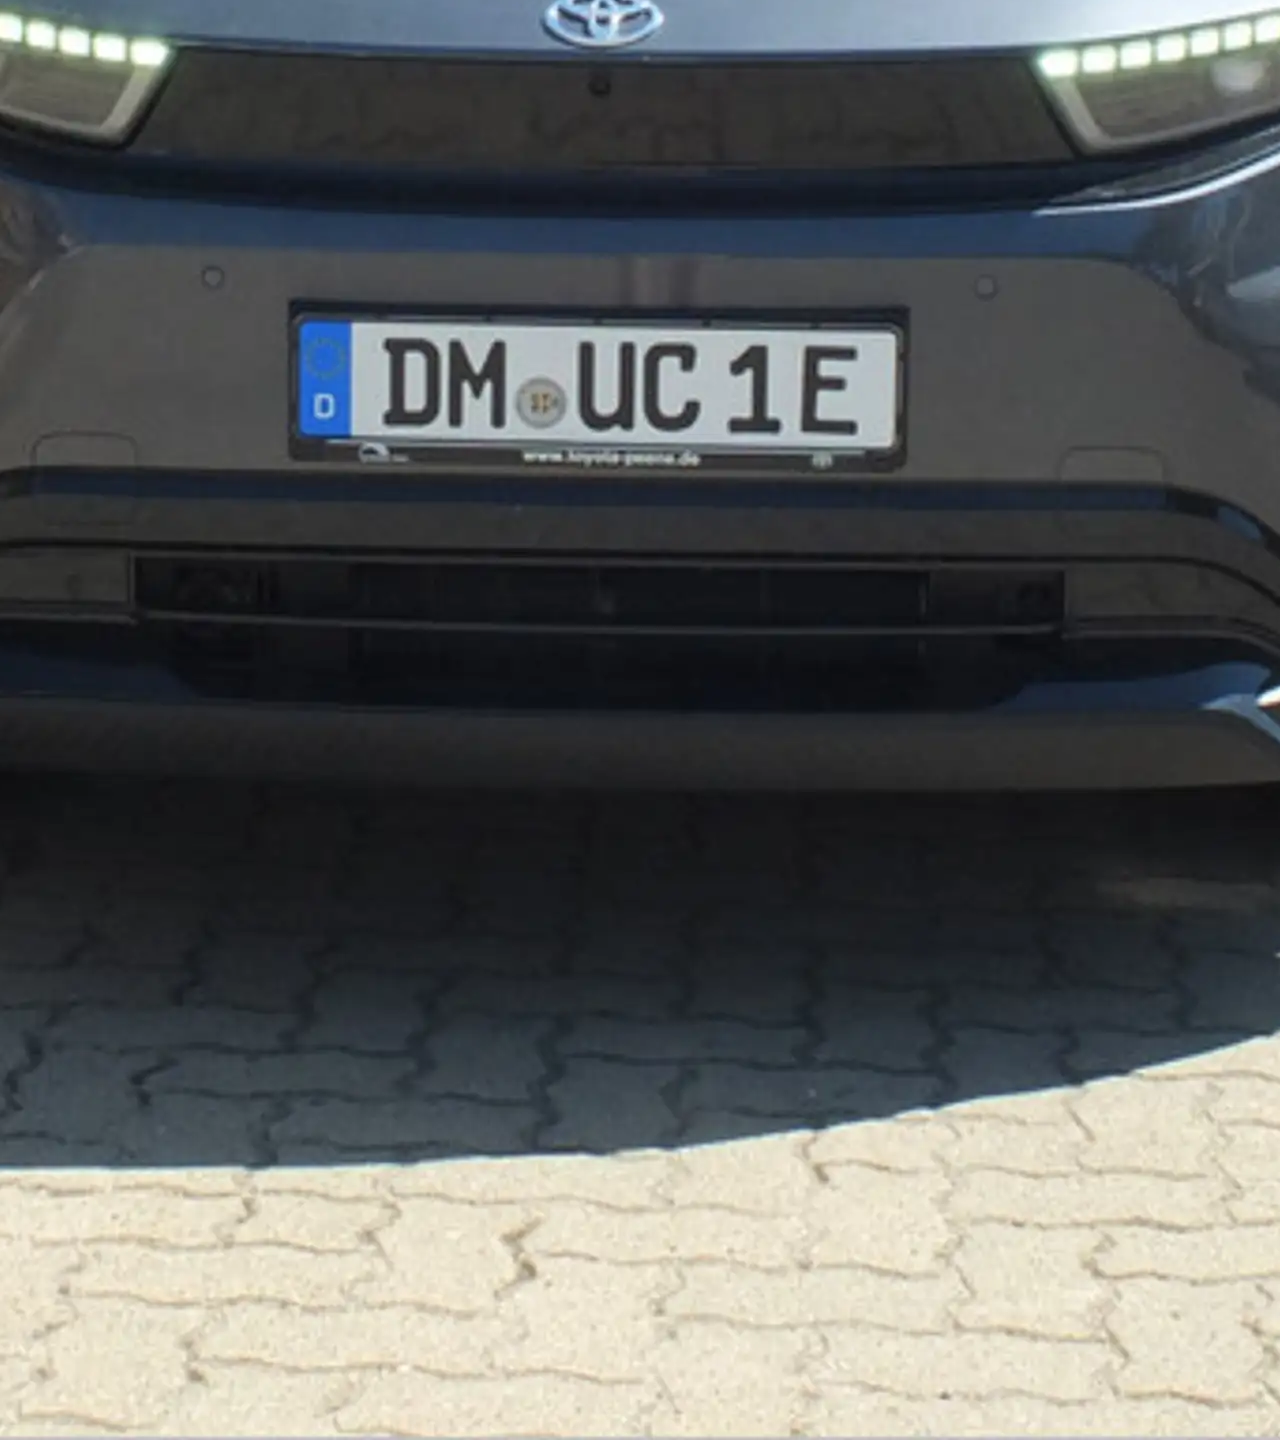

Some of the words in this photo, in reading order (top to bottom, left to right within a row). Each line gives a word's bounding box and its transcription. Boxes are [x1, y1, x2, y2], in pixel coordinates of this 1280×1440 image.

[313, 392, 335, 419] D
[382, 337, 506, 429] DM
[578, 341, 701, 433] UC
[728, 345, 858, 436] 1E
